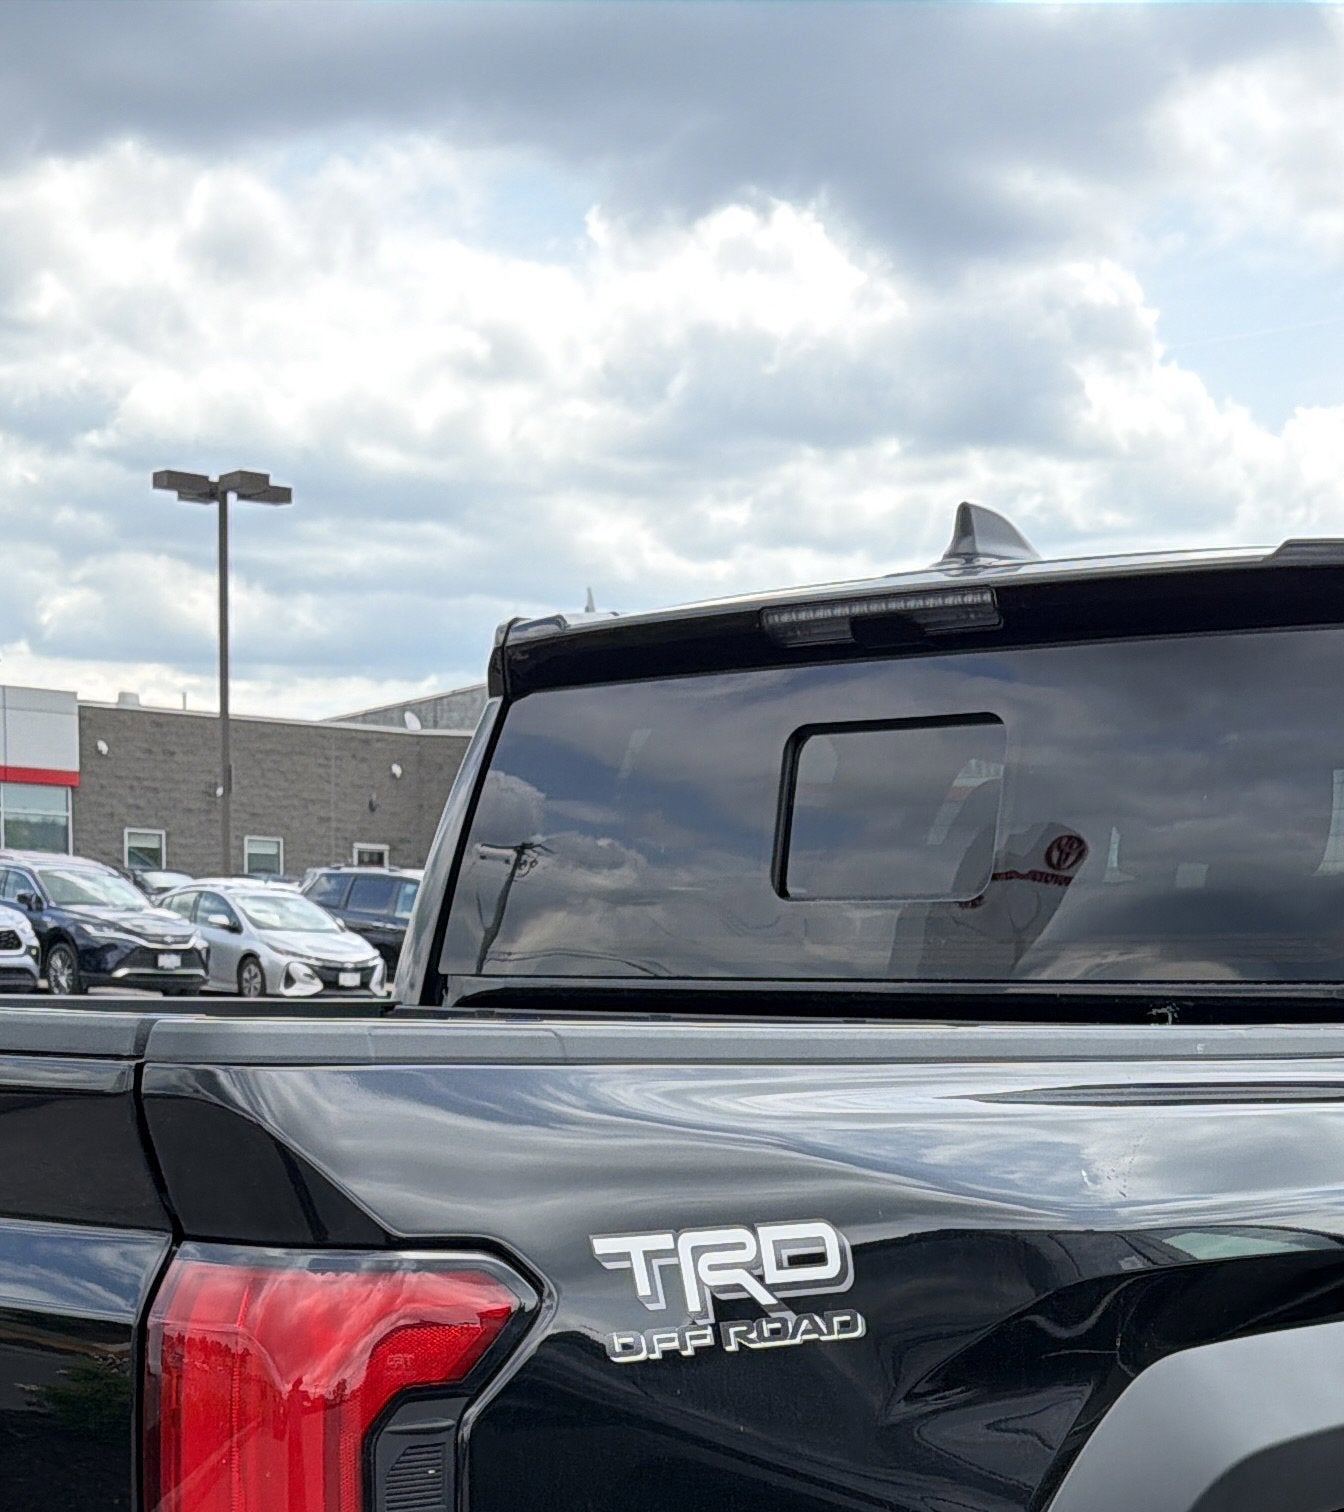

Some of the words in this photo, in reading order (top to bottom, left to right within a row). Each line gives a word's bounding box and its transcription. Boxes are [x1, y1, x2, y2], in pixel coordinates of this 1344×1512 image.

[589, 1218, 855, 1326] TRD
[605, 1322, 715, 1364] OFF
[719, 1308, 867, 1353] ROAD
